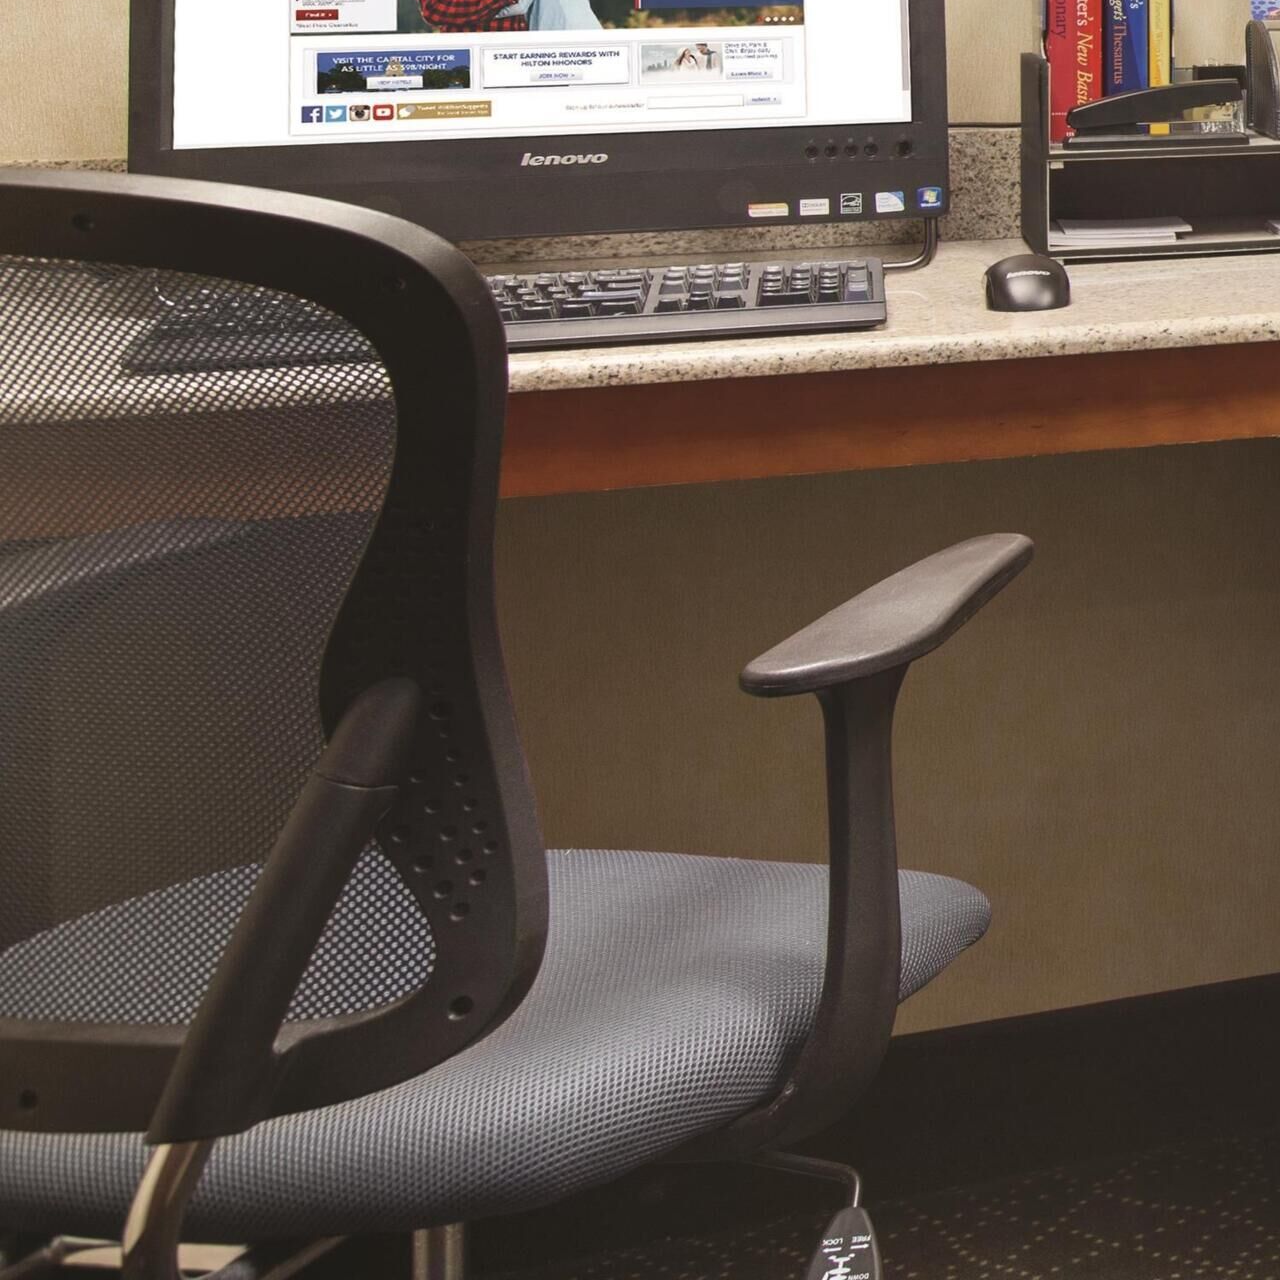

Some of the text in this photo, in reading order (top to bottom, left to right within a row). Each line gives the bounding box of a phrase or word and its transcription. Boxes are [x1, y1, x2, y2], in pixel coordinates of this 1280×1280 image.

[1077, 31, 1093, 66] New
[1114, 22, 1127, 84] Thesaurus
[437, 54, 455, 62] FOR
[521, 153, 608, 166] lenovo
[822, 1237, 843, 1246] LOCK
[852, 1234, 871, 1243] FREE
